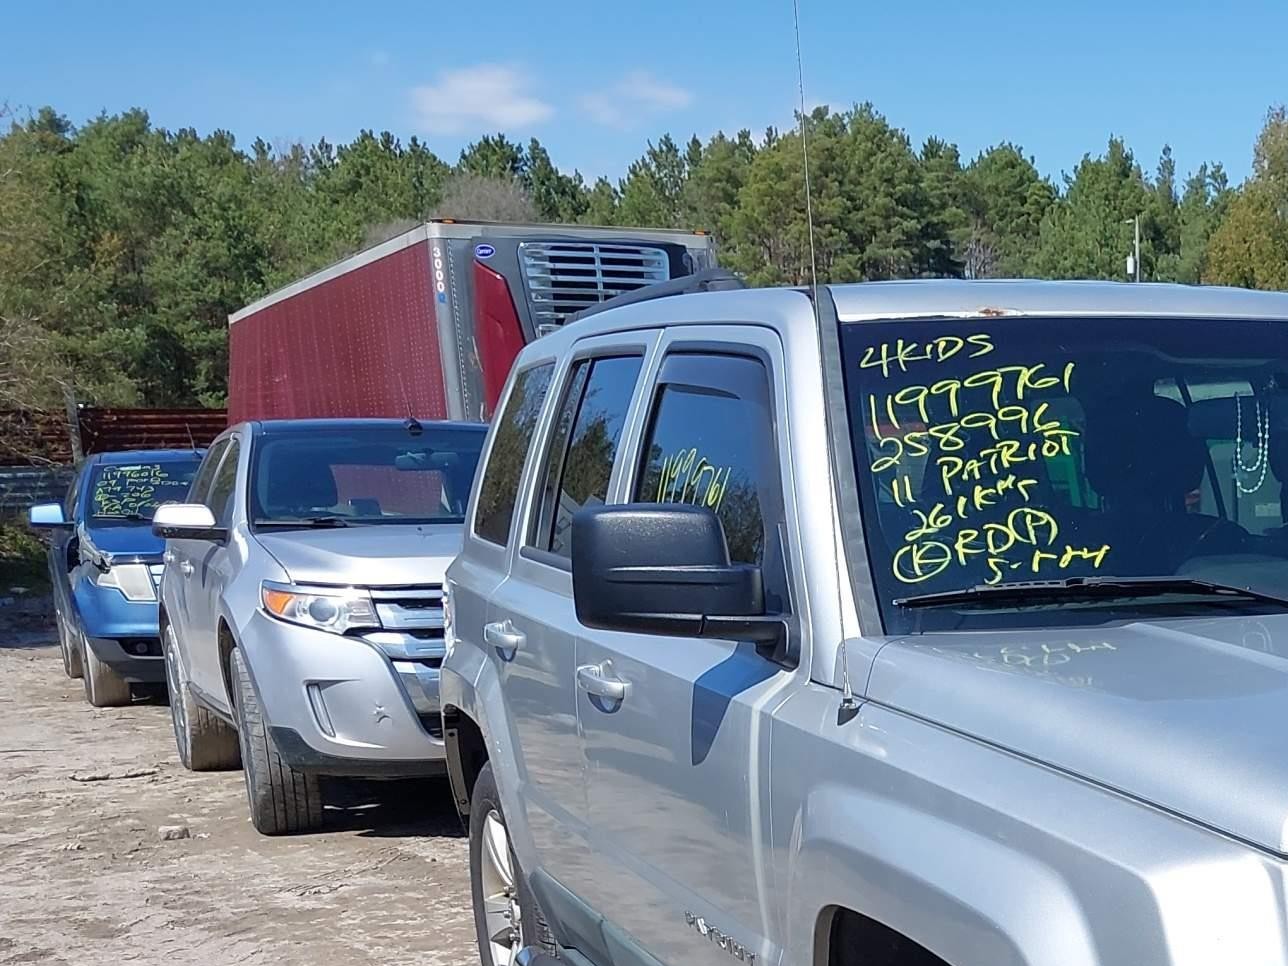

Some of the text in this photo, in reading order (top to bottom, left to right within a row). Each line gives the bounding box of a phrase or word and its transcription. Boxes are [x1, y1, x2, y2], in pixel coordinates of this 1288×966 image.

[870, 362, 1076, 440] 11999761
[870, 402, 1061, 473] 258996
[936, 429, 1081, 496] PATRIOT
